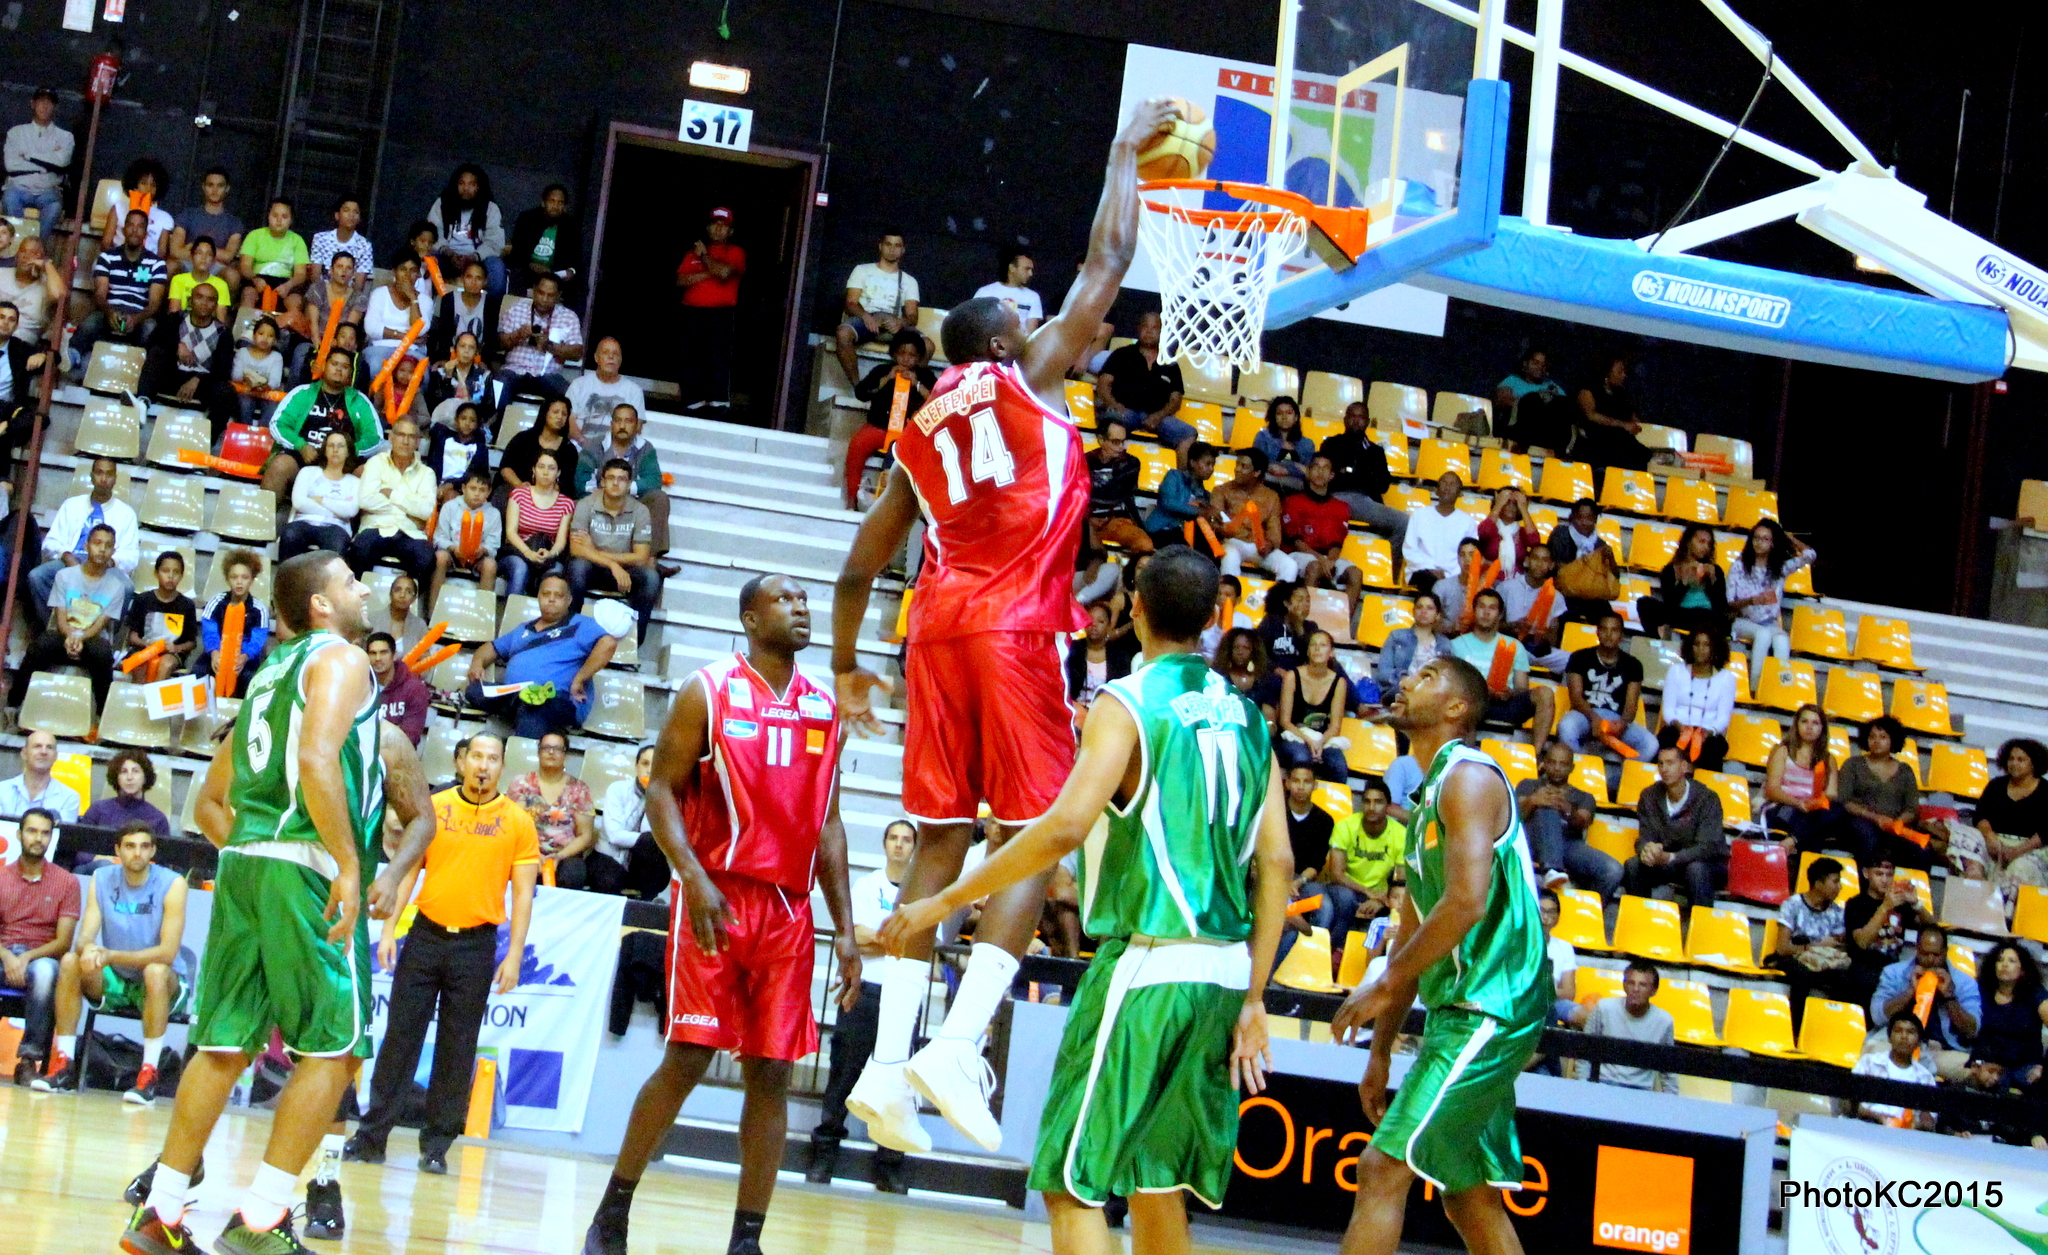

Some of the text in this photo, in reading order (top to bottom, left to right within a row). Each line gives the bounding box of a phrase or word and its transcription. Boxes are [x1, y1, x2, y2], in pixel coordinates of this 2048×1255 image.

[1663, 281, 1786, 323] NOUANSPORT
[916, 387, 967, 432] L'EFFET
[934, 407, 1016, 506] 14
[247, 688, 276, 774] 5
[760, 706, 800, 721] LEGEA
[766, 725, 792, 767] 11
[673, 1013, 720, 1028] LEGEA
[1233, 1096, 1549, 1217] Orae
[1599, 1221, 1680, 1252] orange
